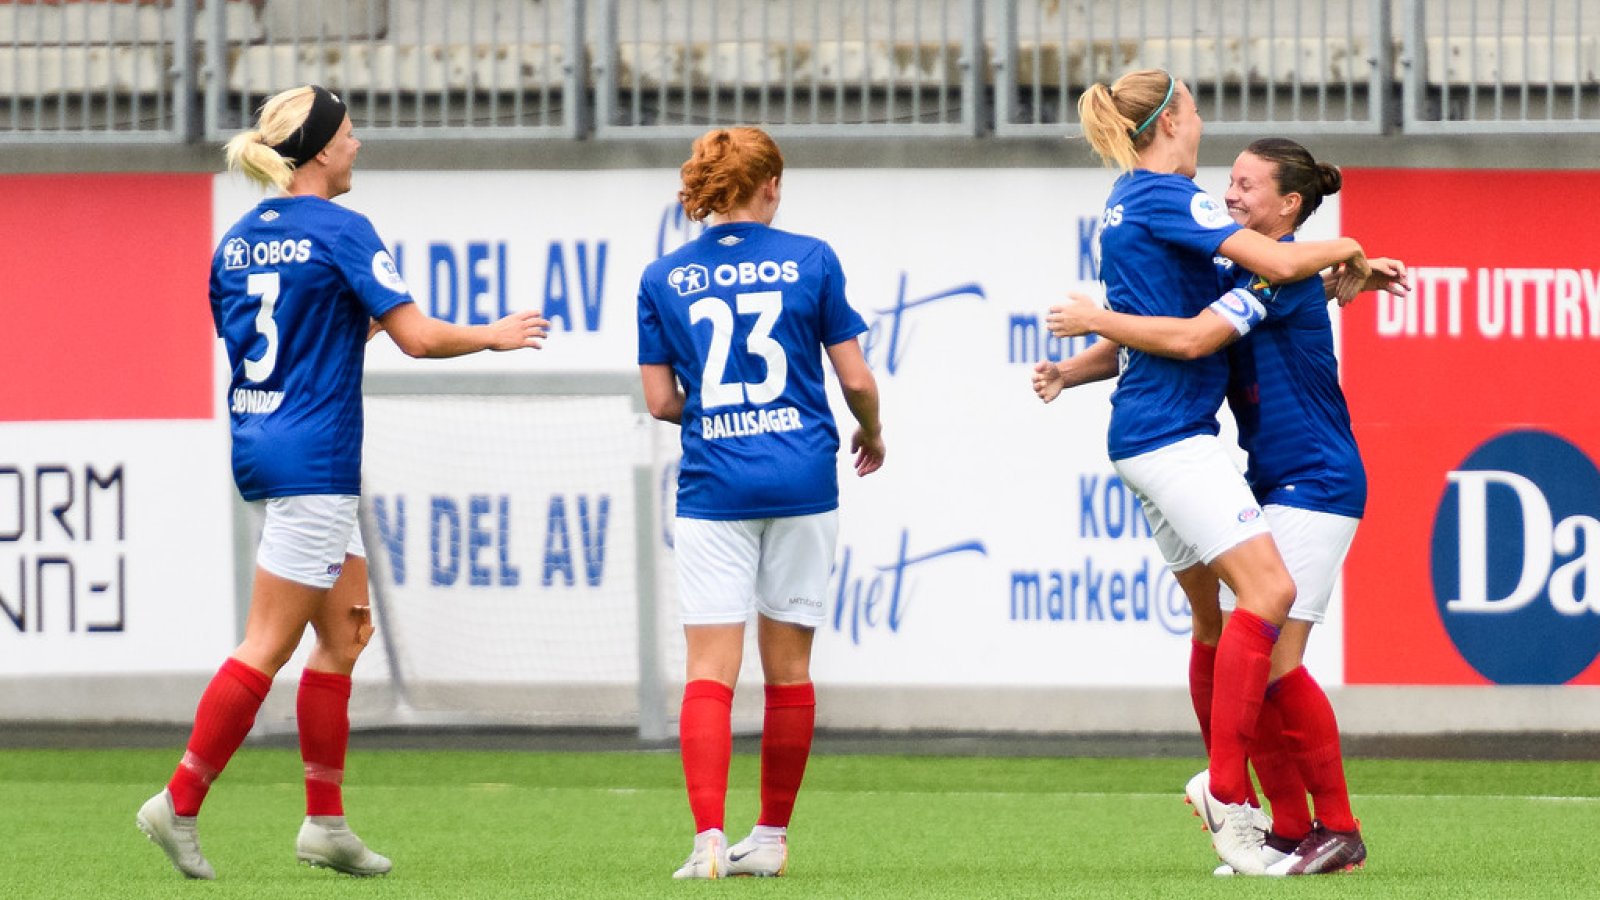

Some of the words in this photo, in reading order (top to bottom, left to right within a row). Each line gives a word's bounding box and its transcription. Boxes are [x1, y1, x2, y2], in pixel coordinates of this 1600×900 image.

[253, 239, 312, 266] OBOS
[713, 260, 799, 286] OBOS
[428, 240, 514, 326] DEL
[541, 240, 609, 332] AV
[244, 272, 280, 383] 3
[688, 290, 787, 410] 23
[700, 406, 803, 440] BALLISAGER
[429, 494, 520, 587] DEL
[541, 494, 611, 587] AV
[788, 596, 823, 608] umbro
